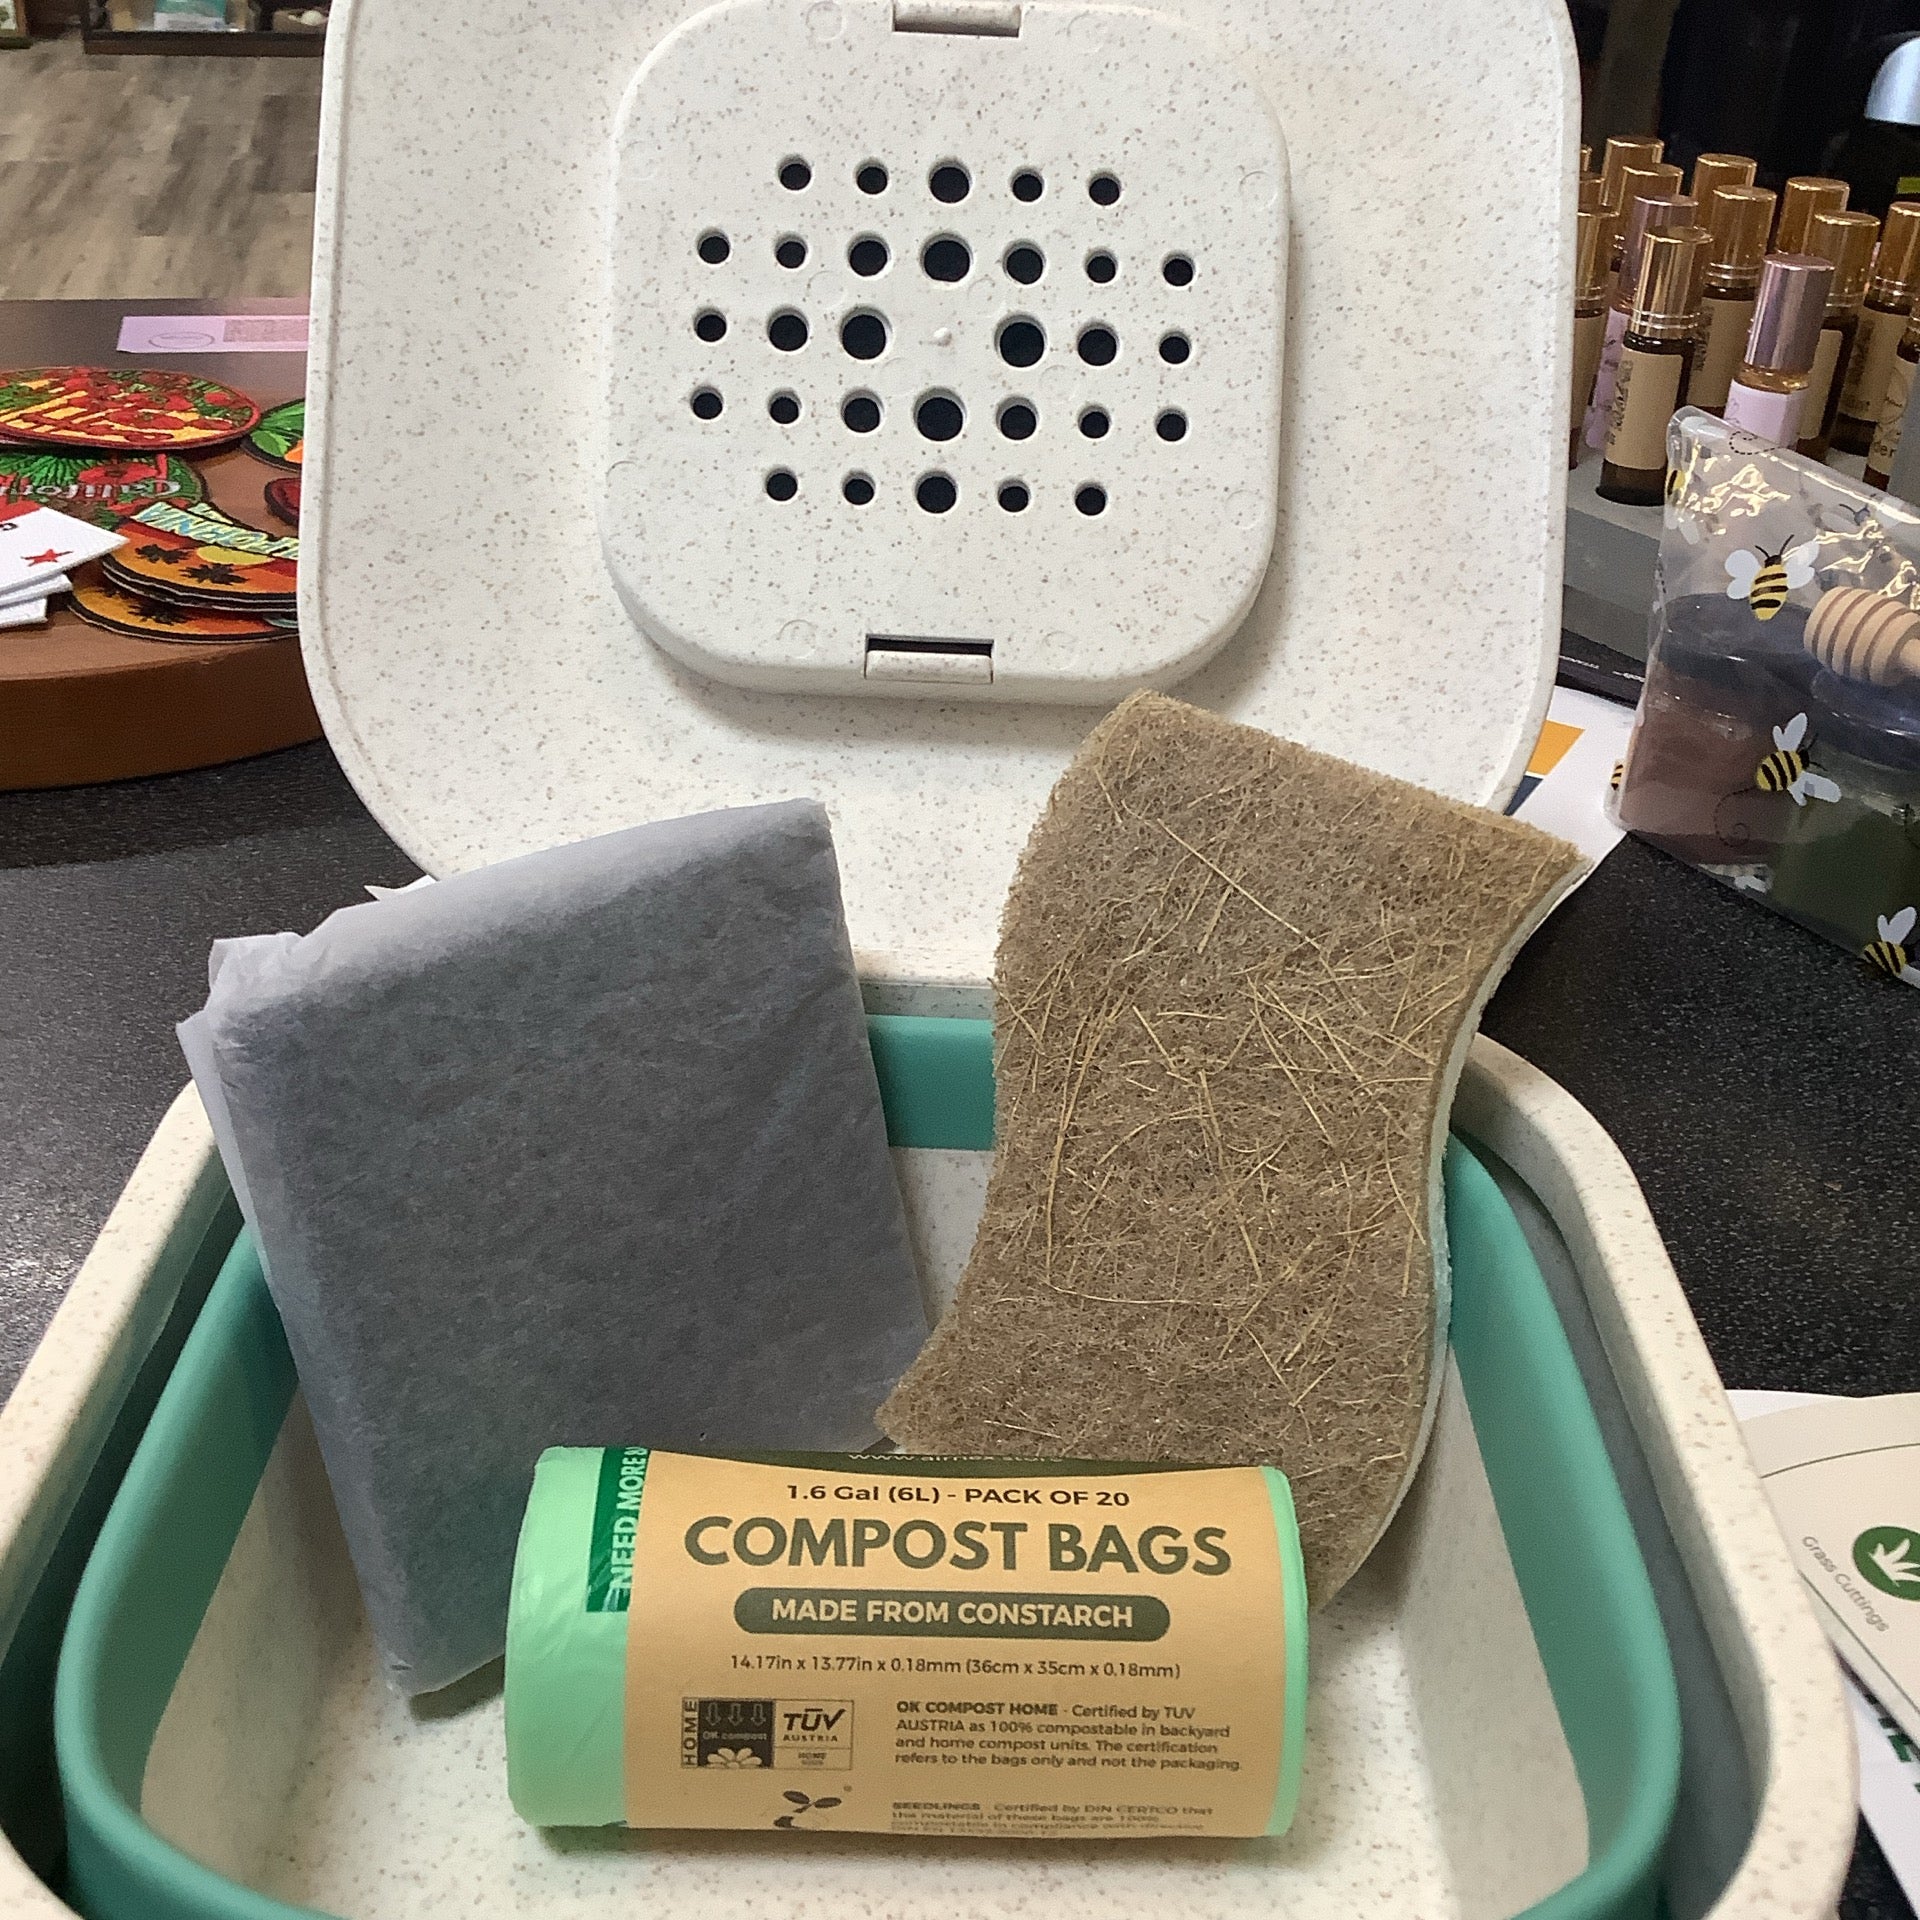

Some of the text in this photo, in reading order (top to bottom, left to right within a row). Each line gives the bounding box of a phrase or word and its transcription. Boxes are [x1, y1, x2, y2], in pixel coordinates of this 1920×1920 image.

[616, 1457, 647, 1511] MORE
[787, 1485, 827, 1499] 1.6
[834, 1485, 879, 1500] Gal
[889, 1486, 940, 1504] (6L)
[965, 1488, 1043, 1504] PACK
[1050, 1490, 1089, 1505] OF
[1097, 1491, 1130, 1506] 20
[609, 1516, 638, 1589] NEED
[684, 1515, 1232, 1576] COMPOST BAGS
[1801, 1535, 1890, 1633] Grass Cuttings
[772, 1598, 1133, 1628] MADE FROM CONSTARCH
[731, 1655, 1181, 1679] 14.17in x 13.77in x 0.18mm (36cm x 35cm x 0.18mm)
[896, 1701, 920, 1713] OK
[925, 1702, 1006, 1714] COMPOST
[1009, 1702, 1059, 1715] HOME
[1072, 1704, 1138, 1719] Certified
[1141, 1705, 1160, 1721] by
[1164, 1706, 1196, 1719] TUV
[684, 1699, 698, 1766] HOME
[783, 1734, 839, 1743] AUSTRIA
[896, 1719, 1231, 1740] AUSTRIA as 100% compostable in backyard
[895, 1737, 926, 1748] and
[930, 1737, 975, 1748] home
[979, 1738, 1046, 1752] compost
[1096, 1740, 1123, 1751] The
[1126, 1741, 1218, 1753] certification
[895, 1752, 938, 1764] refers
[942, 1753, 958, 1764] to
[962, 1753, 987, 1764] the
[991, 1754, 1027, 1767] bags
[1031, 1755, 1063, 1768] only
[1067, 1756, 1097, 1766] and
[1101, 1757, 1127, 1767] not
[1131, 1757, 1157, 1768] the
